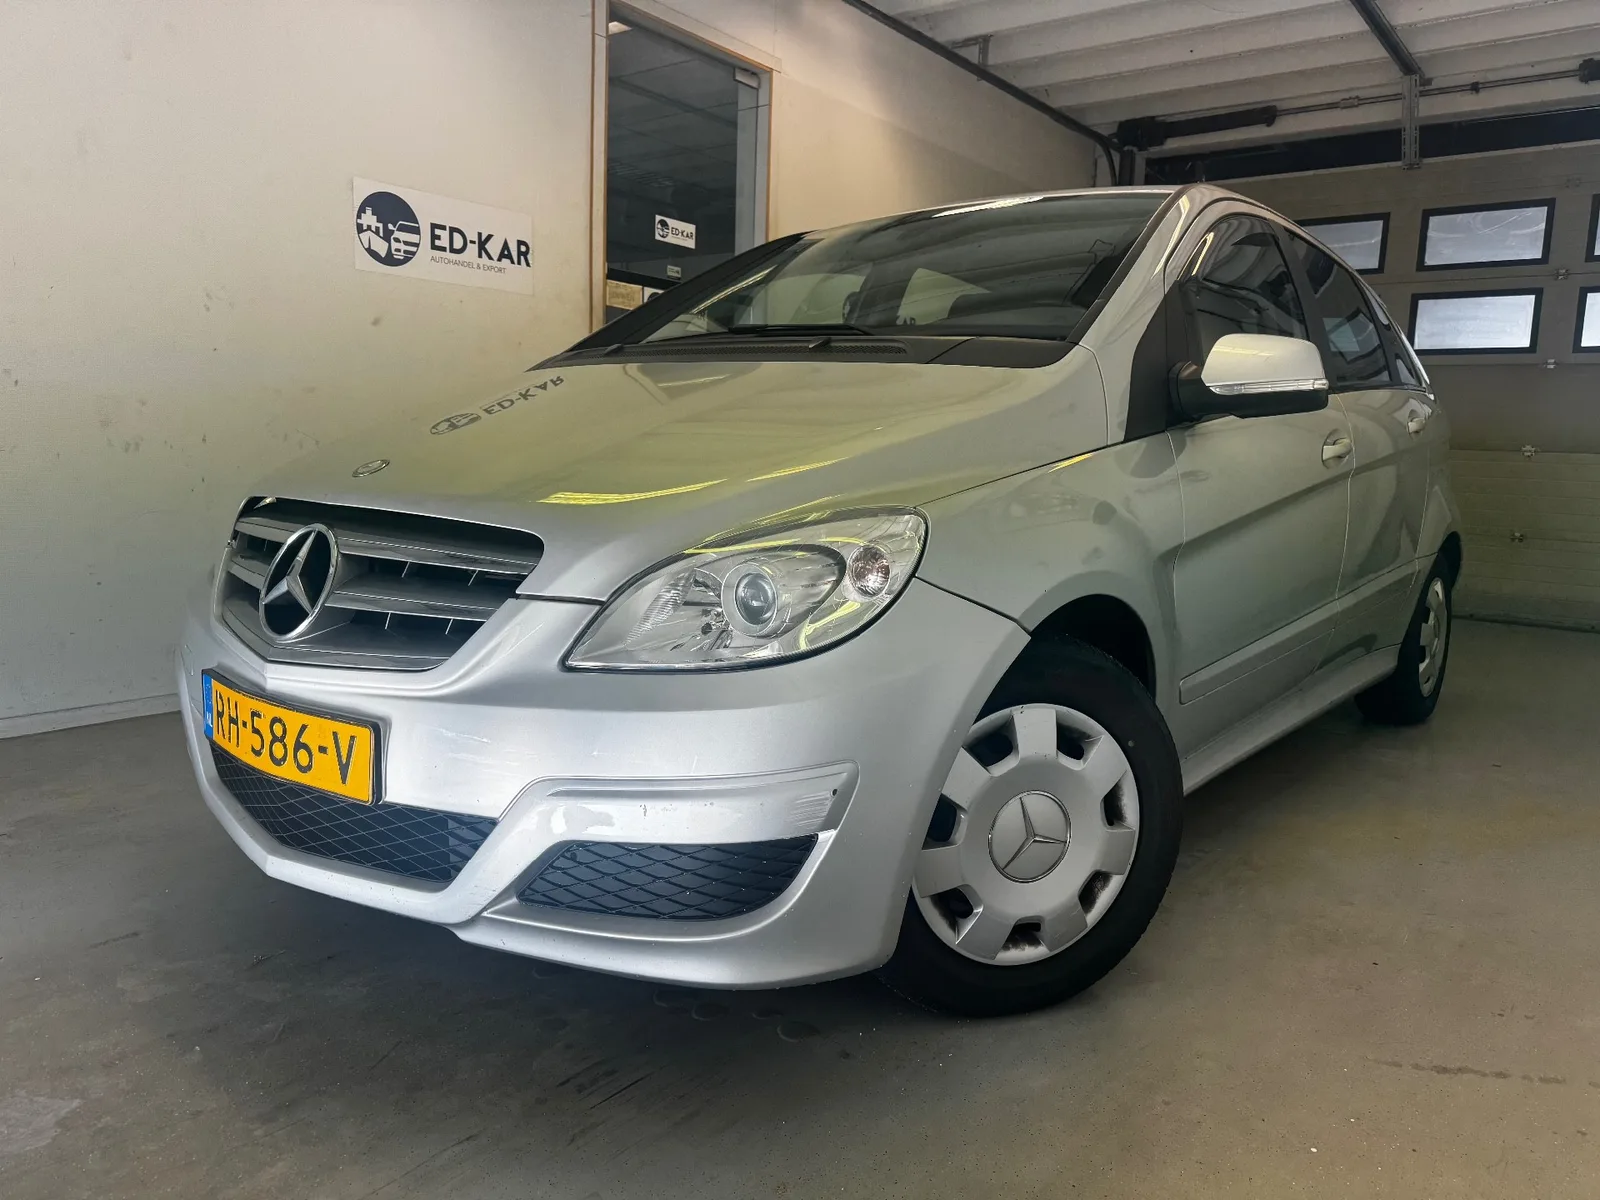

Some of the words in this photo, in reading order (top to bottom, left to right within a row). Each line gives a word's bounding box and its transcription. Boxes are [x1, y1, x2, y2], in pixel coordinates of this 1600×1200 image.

[430, 222, 531, 268] ED-KAR
[671, 226, 694, 240] ED-KAR
[430, 255, 475, 270] AUTOHANDEL
[476, 262, 481, 270] &
[482, 264, 507, 275] EXPORT
[215, 689, 358, 785] RH-586-V
